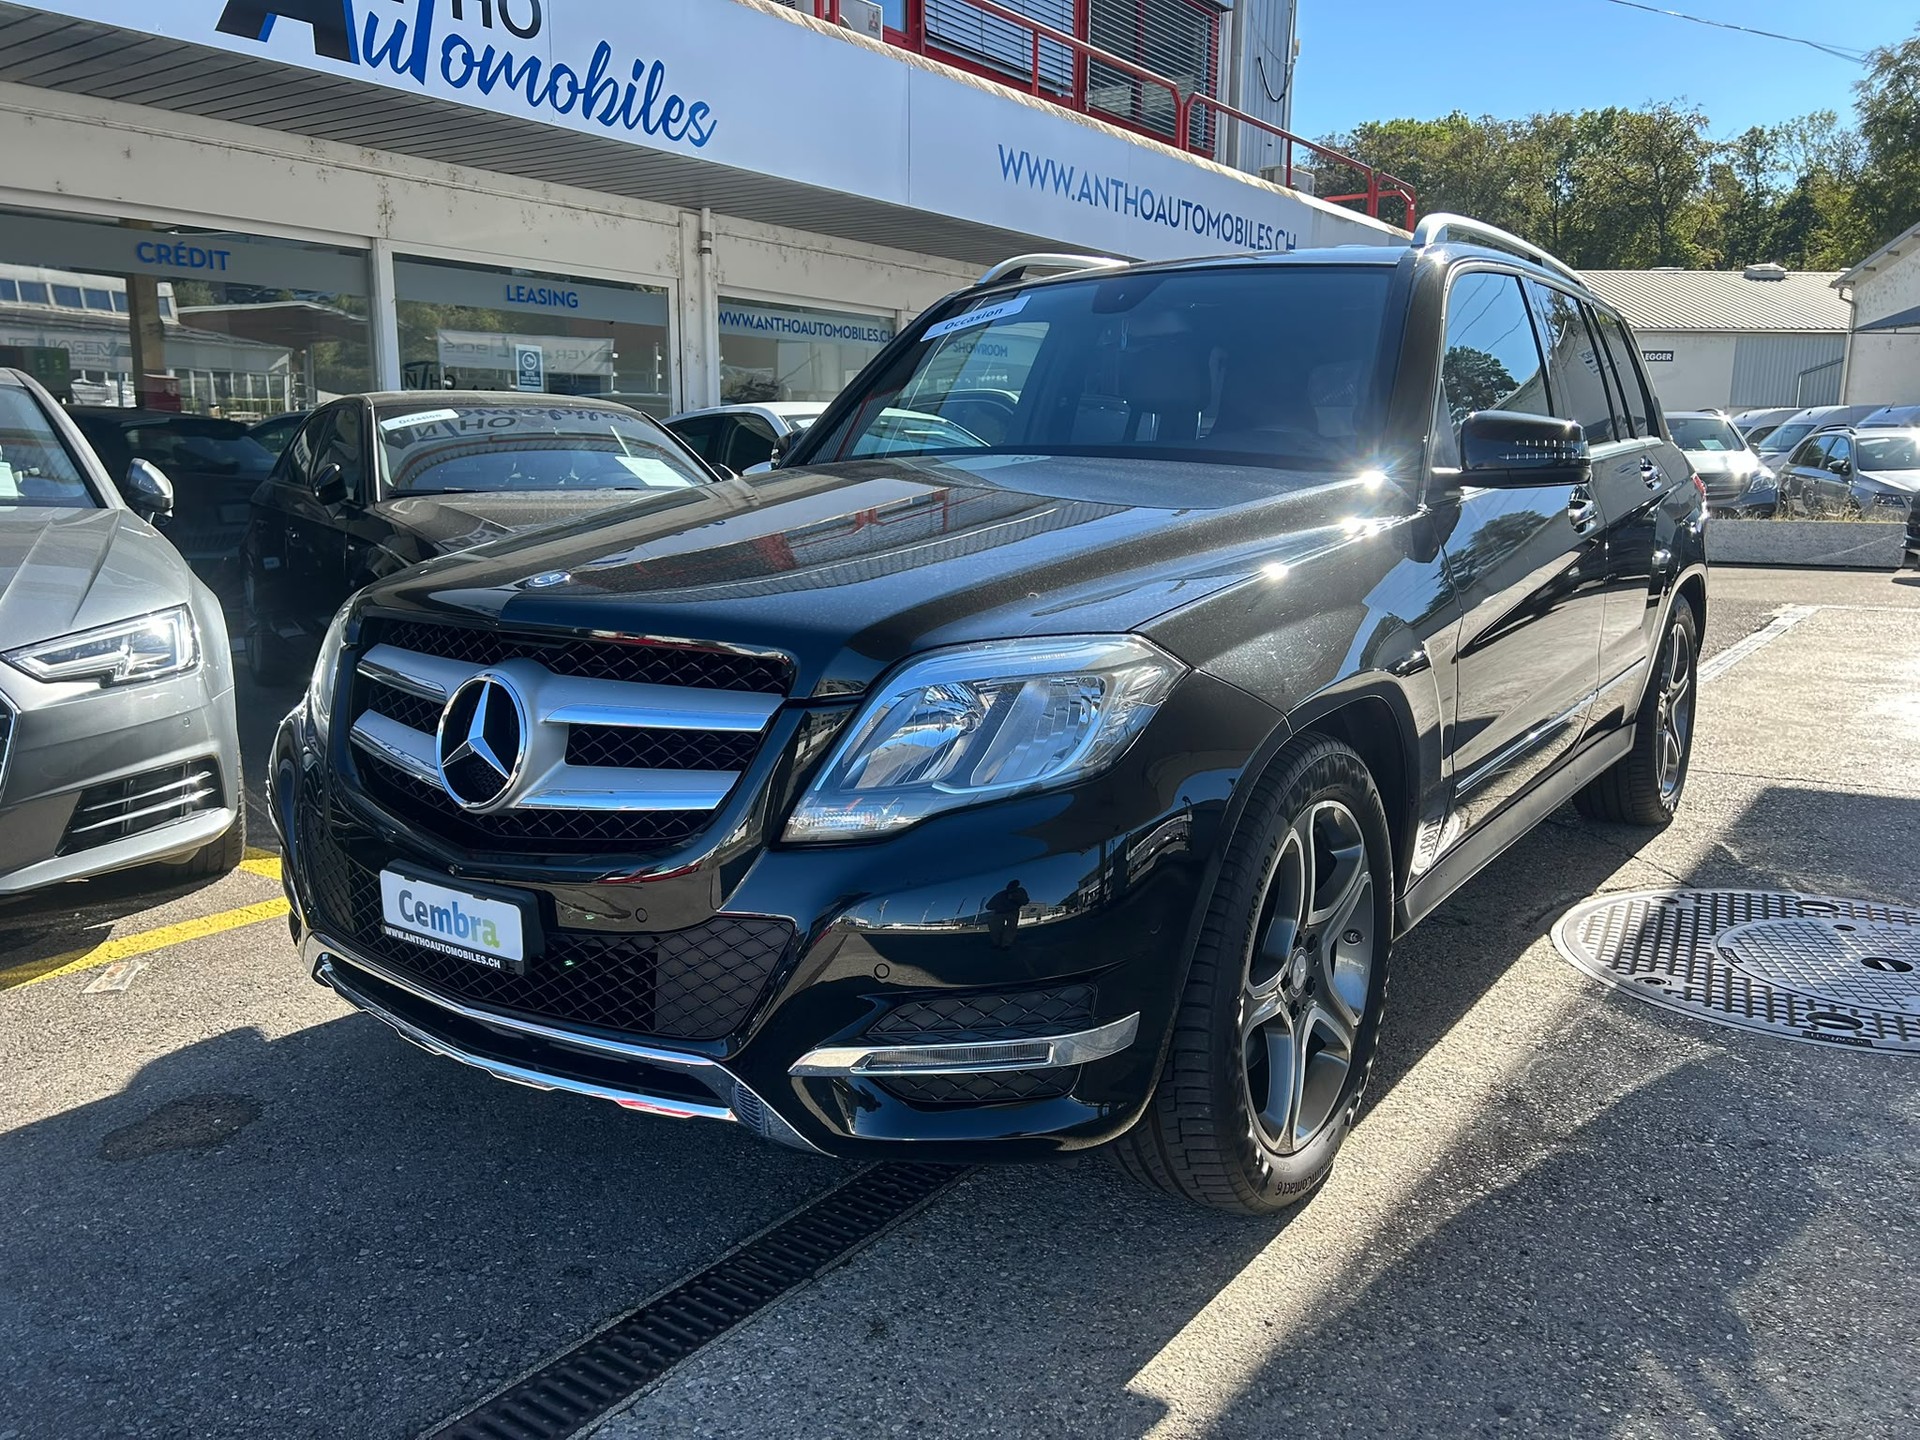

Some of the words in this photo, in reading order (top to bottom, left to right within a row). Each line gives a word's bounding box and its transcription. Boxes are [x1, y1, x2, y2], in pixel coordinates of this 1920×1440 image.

[997, 144, 1297, 251] WWW.ANTHOAUTOMOBILESCH
[136, 241, 231, 271] CRÉDIT
[506, 284, 579, 309] LEASING
[718, 311, 896, 343] WWW.ANTHOAUTOMOBILES.CH
[944, 308, 1004, 331] Occasion
[953, 342, 1008, 358] SHOWROOM
[1642, 352, 1672, 361] EGGER
[1261, 855, 1271, 875] 19
[398, 890, 500, 948] Cembra
[384, 926, 501, 969] WWW.ANTHOAUTOMOBILES.CH
